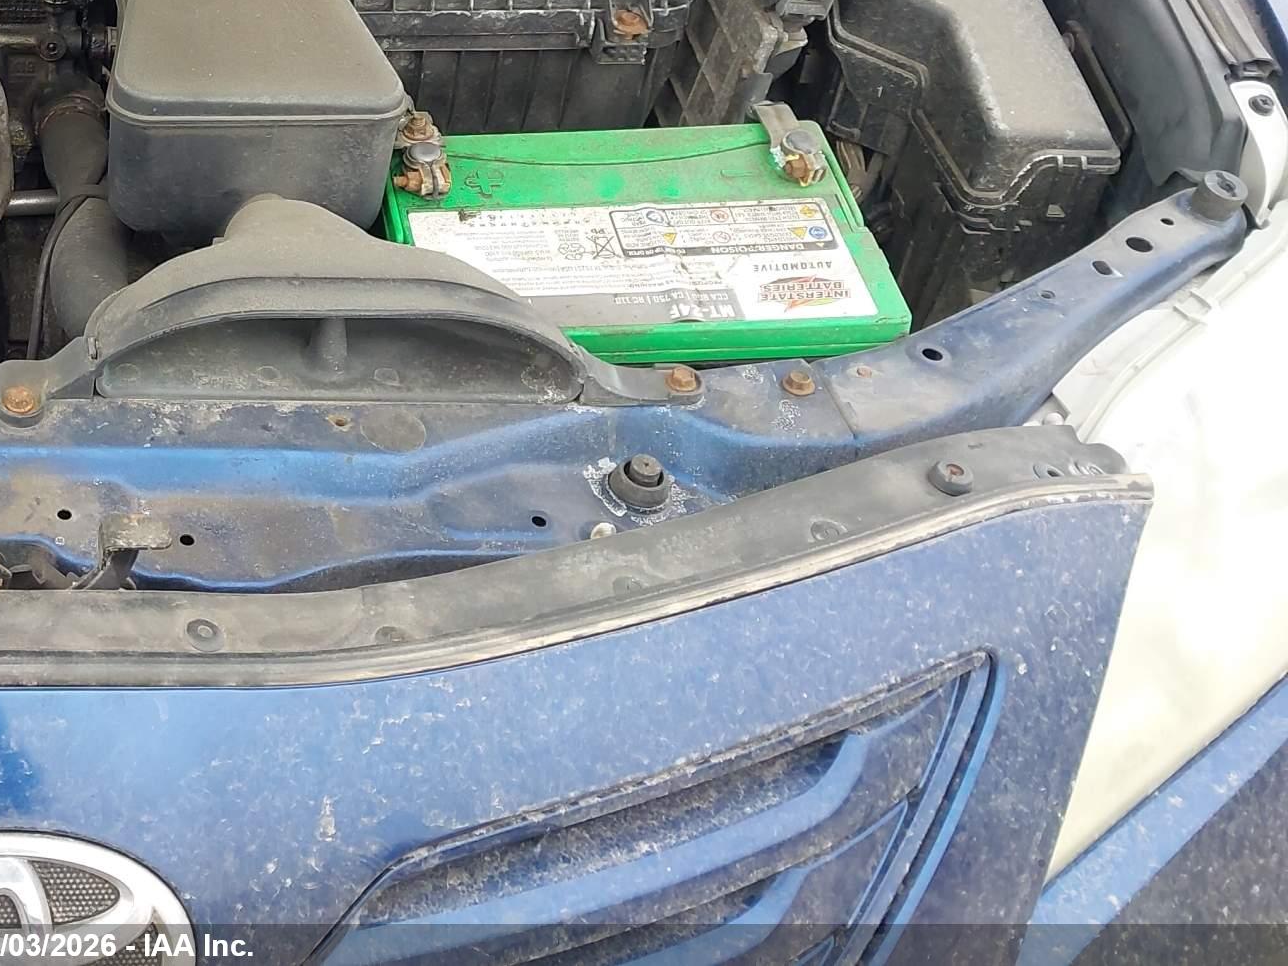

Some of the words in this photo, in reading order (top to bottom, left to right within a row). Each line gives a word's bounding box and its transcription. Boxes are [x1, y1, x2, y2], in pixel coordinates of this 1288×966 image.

[752, 261, 832, 272] AUTOMOTIVE
[762, 281, 842, 292] BATTERIES
[760, 290, 849, 301] INTERSTATE
